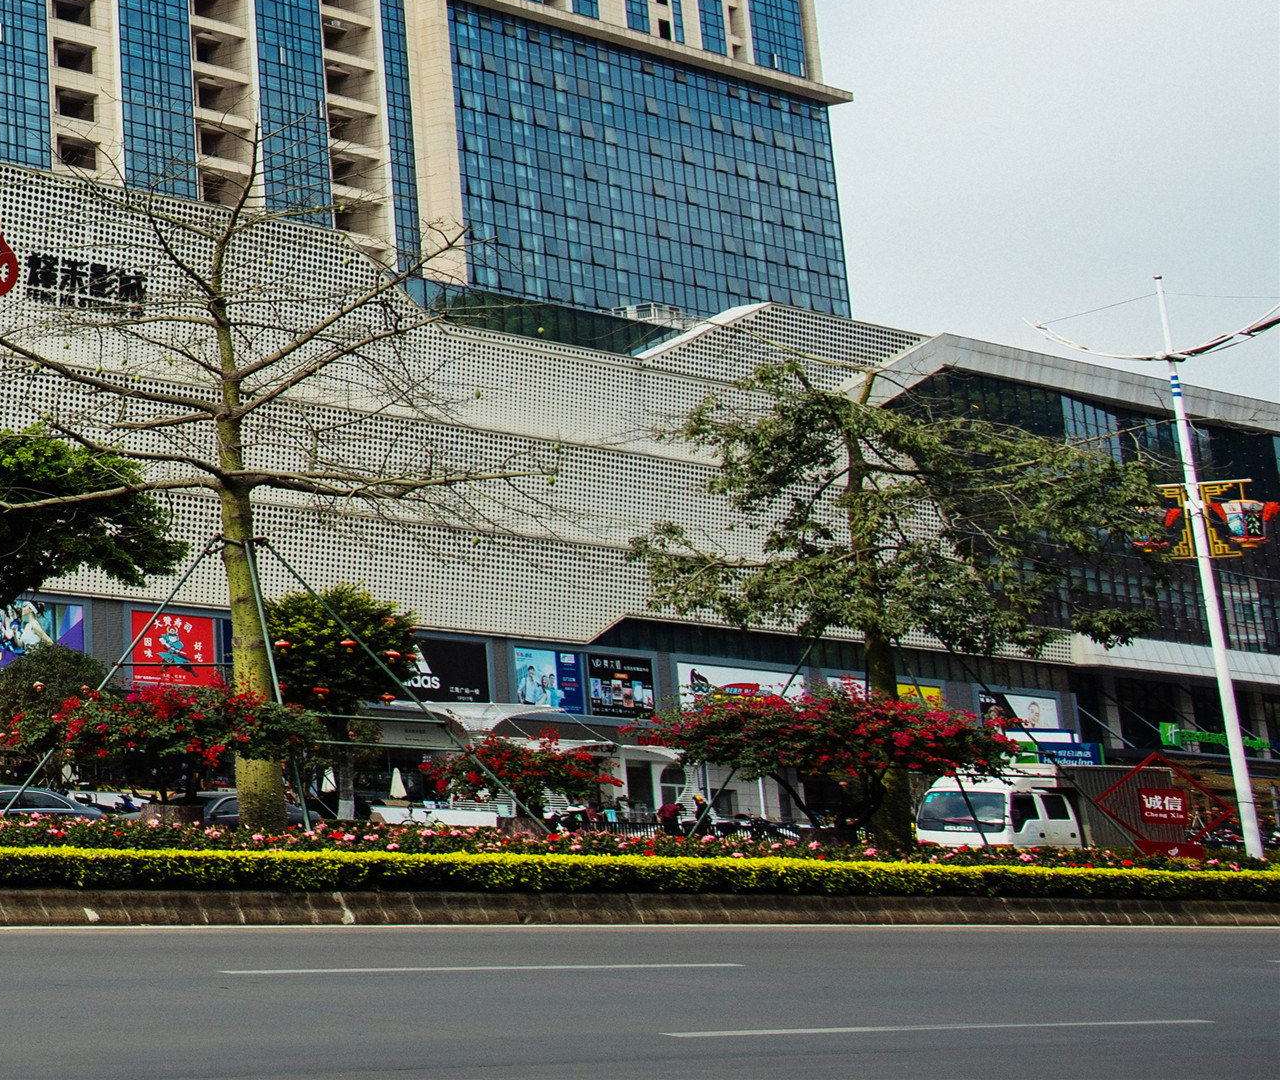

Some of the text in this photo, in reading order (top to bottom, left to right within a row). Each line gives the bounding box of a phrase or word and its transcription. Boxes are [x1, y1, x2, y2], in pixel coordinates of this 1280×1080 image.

[193, 641, 203, 663] 好吃
[1078, 758, 1094, 766] Inn
[1142, 795, 1182, 811] 诚信
